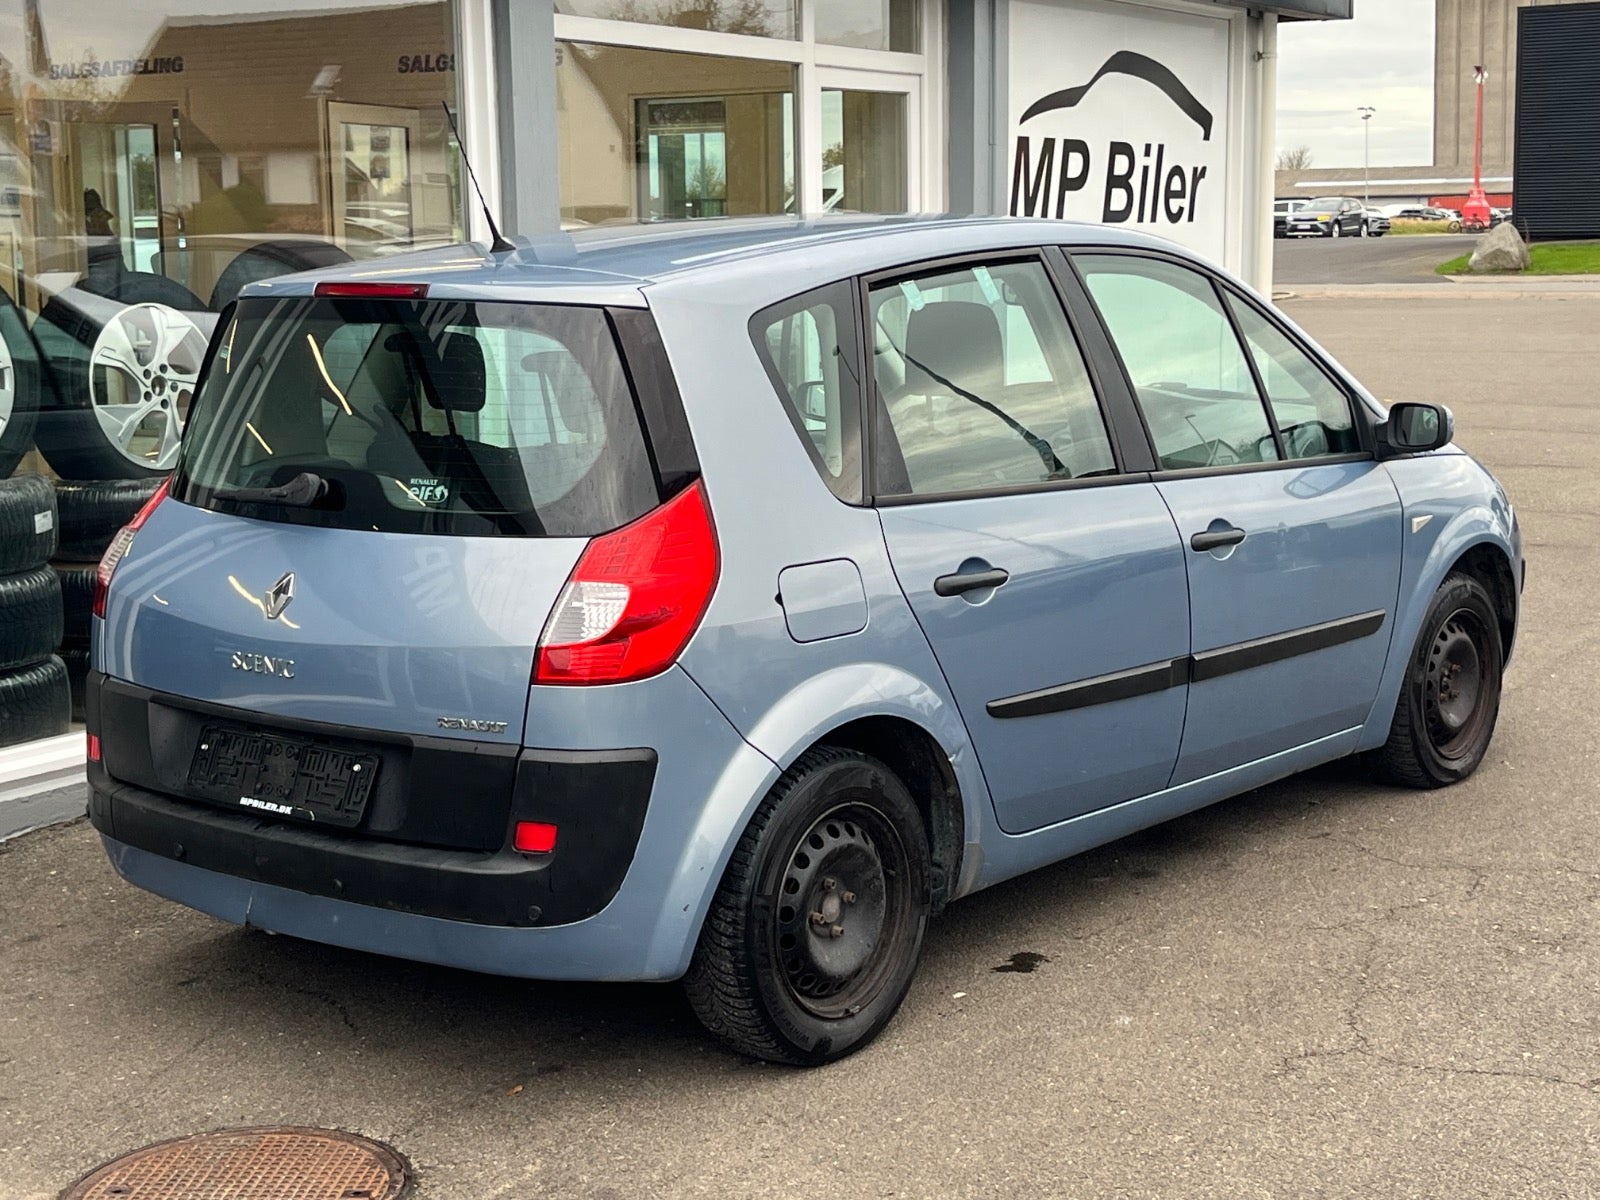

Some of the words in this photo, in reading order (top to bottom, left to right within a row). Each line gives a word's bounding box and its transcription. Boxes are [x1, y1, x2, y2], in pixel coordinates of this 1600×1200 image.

[50, 56, 184, 80] SALGSAFDELING
[1009, 136, 1090, 219] MP
[1102, 141, 1207, 224] Biler
[231, 651, 295, 678] SCENIC
[437, 716, 508, 733] RENAULT
[239, 796, 293, 815] MPBILER.DK
